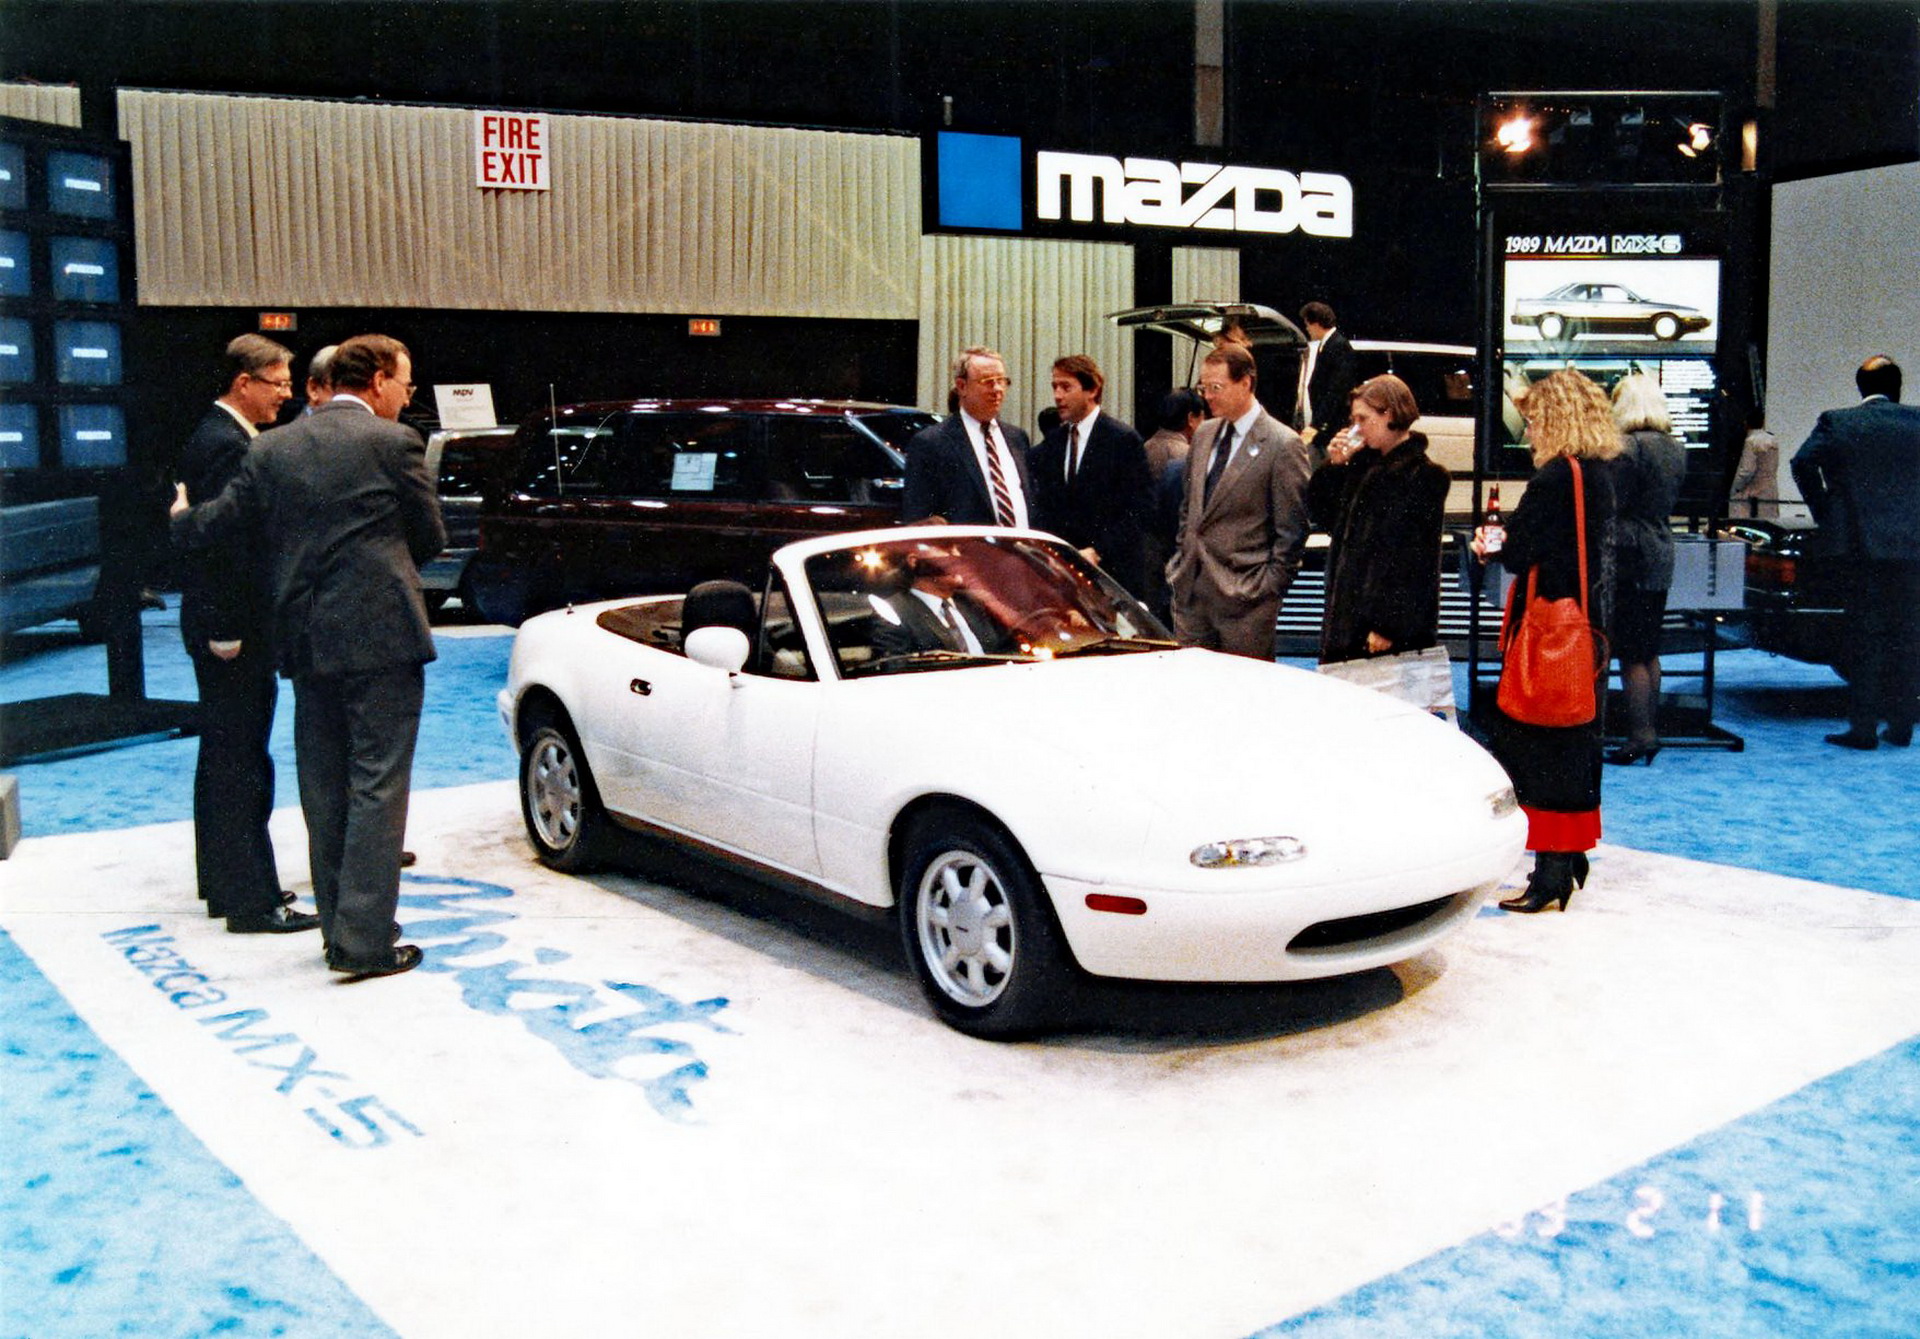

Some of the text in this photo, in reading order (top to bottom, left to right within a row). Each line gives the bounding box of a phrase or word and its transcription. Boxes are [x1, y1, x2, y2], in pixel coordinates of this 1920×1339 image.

[484, 116, 540, 149] FIRE
[483, 151, 542, 184] EXIT
[1037, 151, 1353, 238] mazda
[1505, 235, 1683, 253] 1989 MAZDA MX-6
[195, 1007, 426, 1149] MX-5
